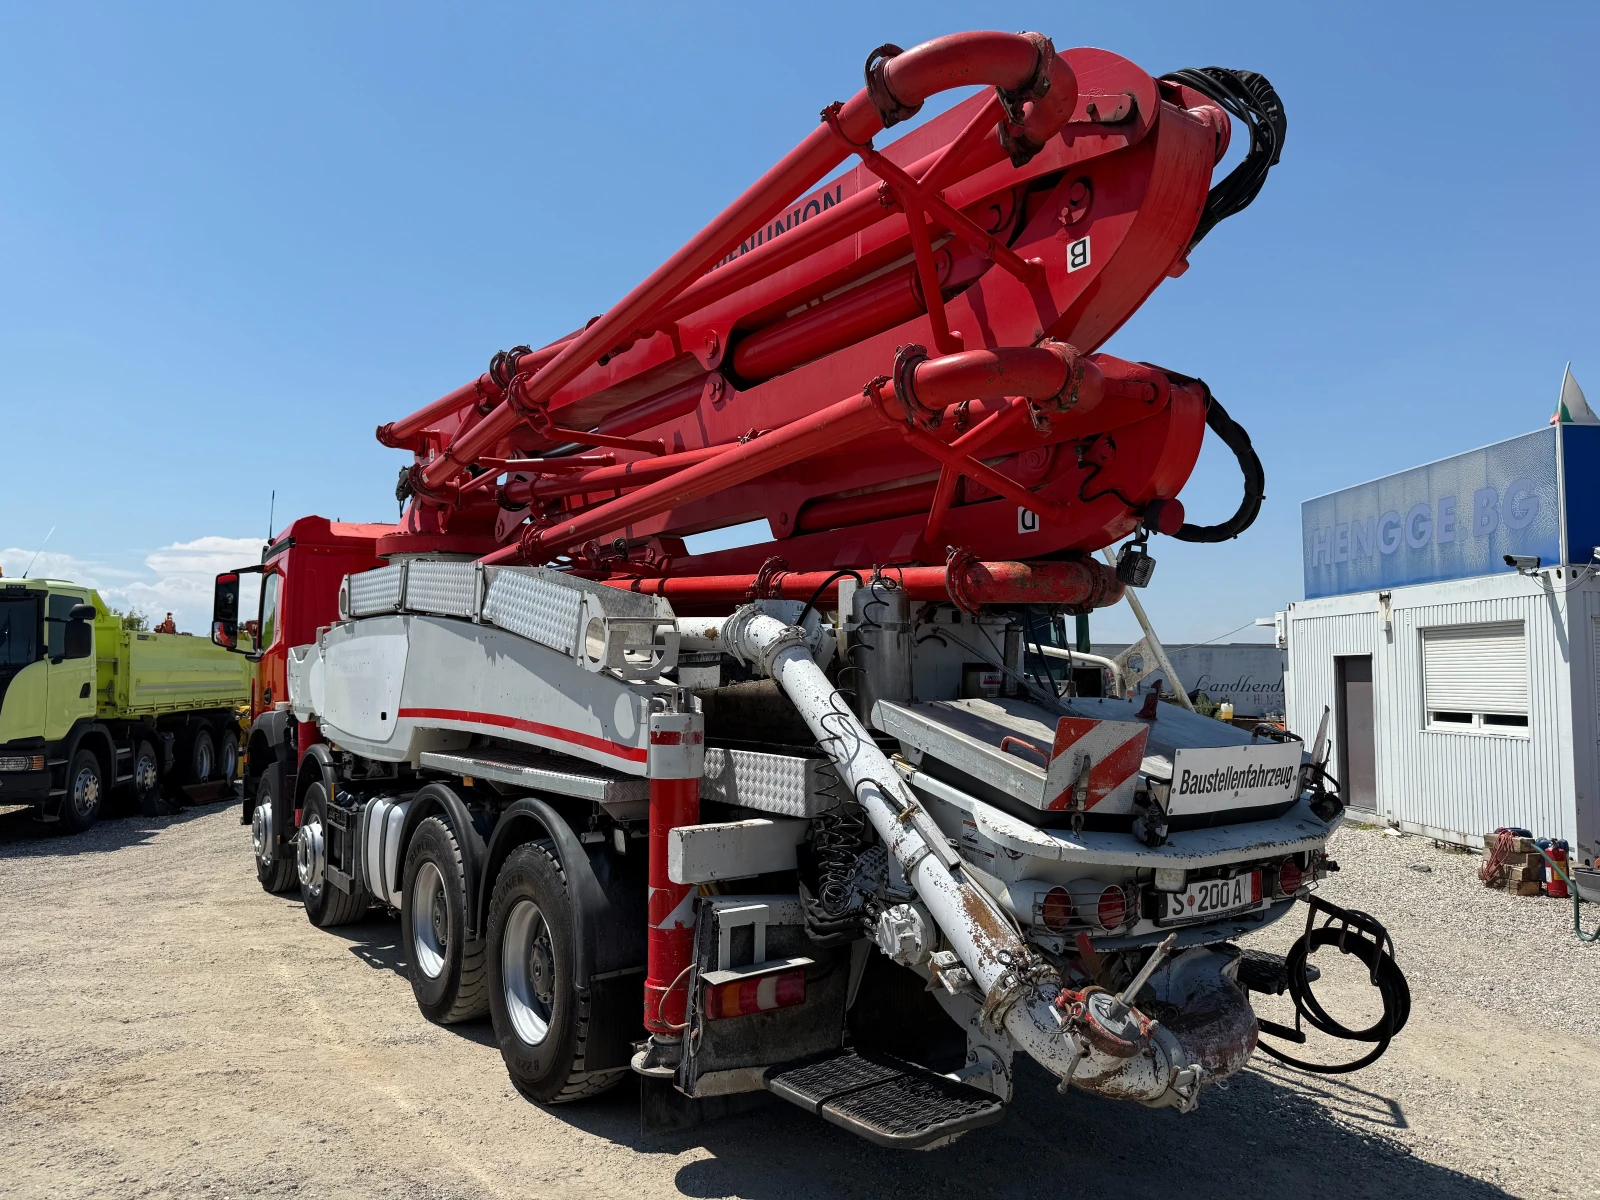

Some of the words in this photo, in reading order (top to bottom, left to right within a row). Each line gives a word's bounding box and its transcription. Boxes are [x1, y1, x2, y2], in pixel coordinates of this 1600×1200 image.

[1070, 239, 1087, 269] B
[1311, 477, 1540, 568] HENGGE.BG
[1178, 763, 1295, 796] Baustellenfahrzeug
[1172, 890, 1185, 916] S
